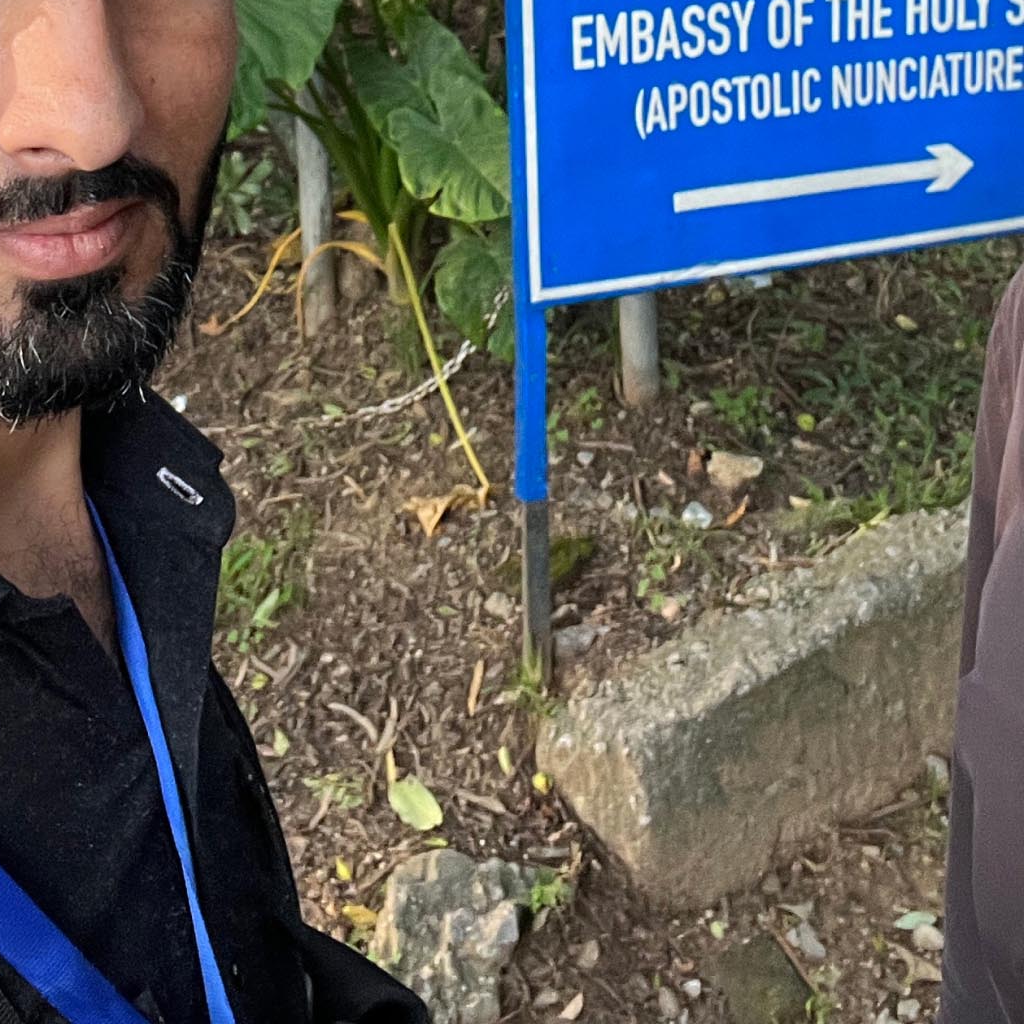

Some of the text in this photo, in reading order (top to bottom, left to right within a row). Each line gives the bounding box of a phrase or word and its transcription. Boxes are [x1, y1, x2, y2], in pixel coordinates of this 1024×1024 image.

[571, 0, 756, 71] EMBASSY
[634, 45, 1024, 141] (APOSTOLIC NUNCIATURE
